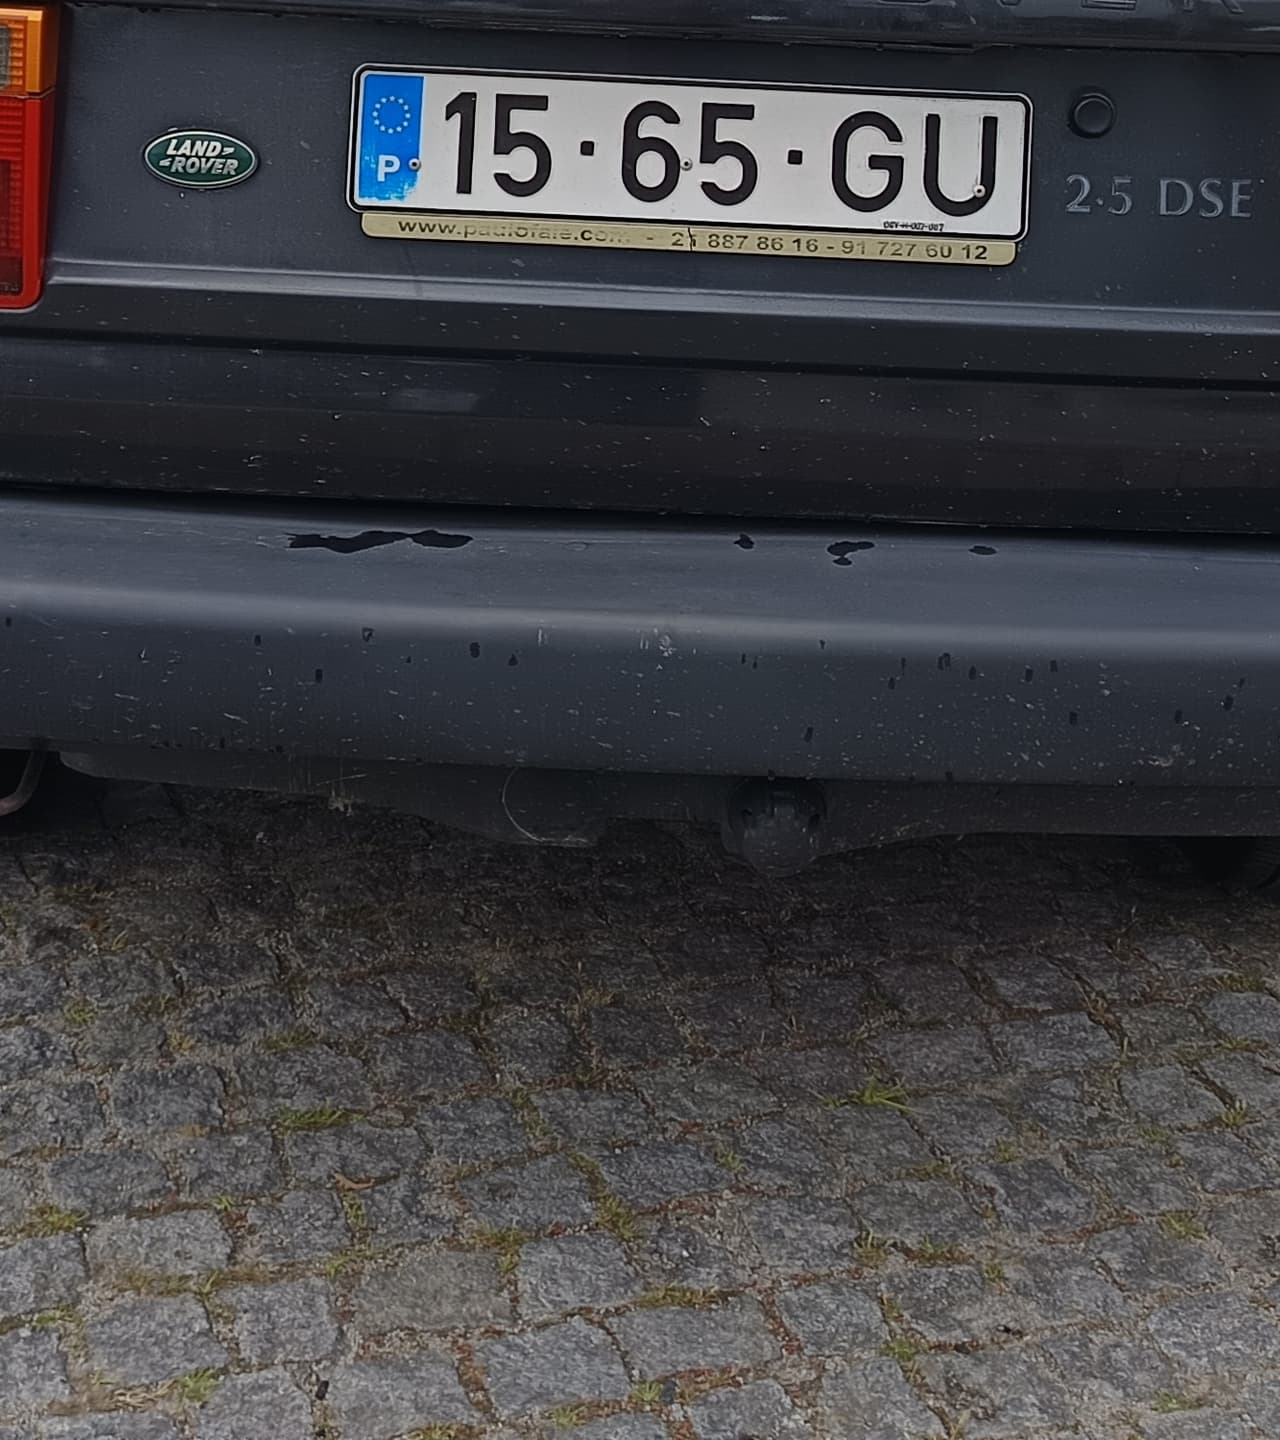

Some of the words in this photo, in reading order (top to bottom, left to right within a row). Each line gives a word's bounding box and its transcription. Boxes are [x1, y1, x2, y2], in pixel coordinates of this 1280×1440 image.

[166, 139, 222, 157] LAND
[170, 157, 239, 175] ROVER
[377, 154, 401, 182] P
[1159, 177, 1252, 218] DSE
[708, 233, 749, 250] 887
[757, 235, 784, 251] 86
[792, 237, 819, 253] 16
[878, 241, 916, 257] 727
[964, 245, 988, 260] 12
